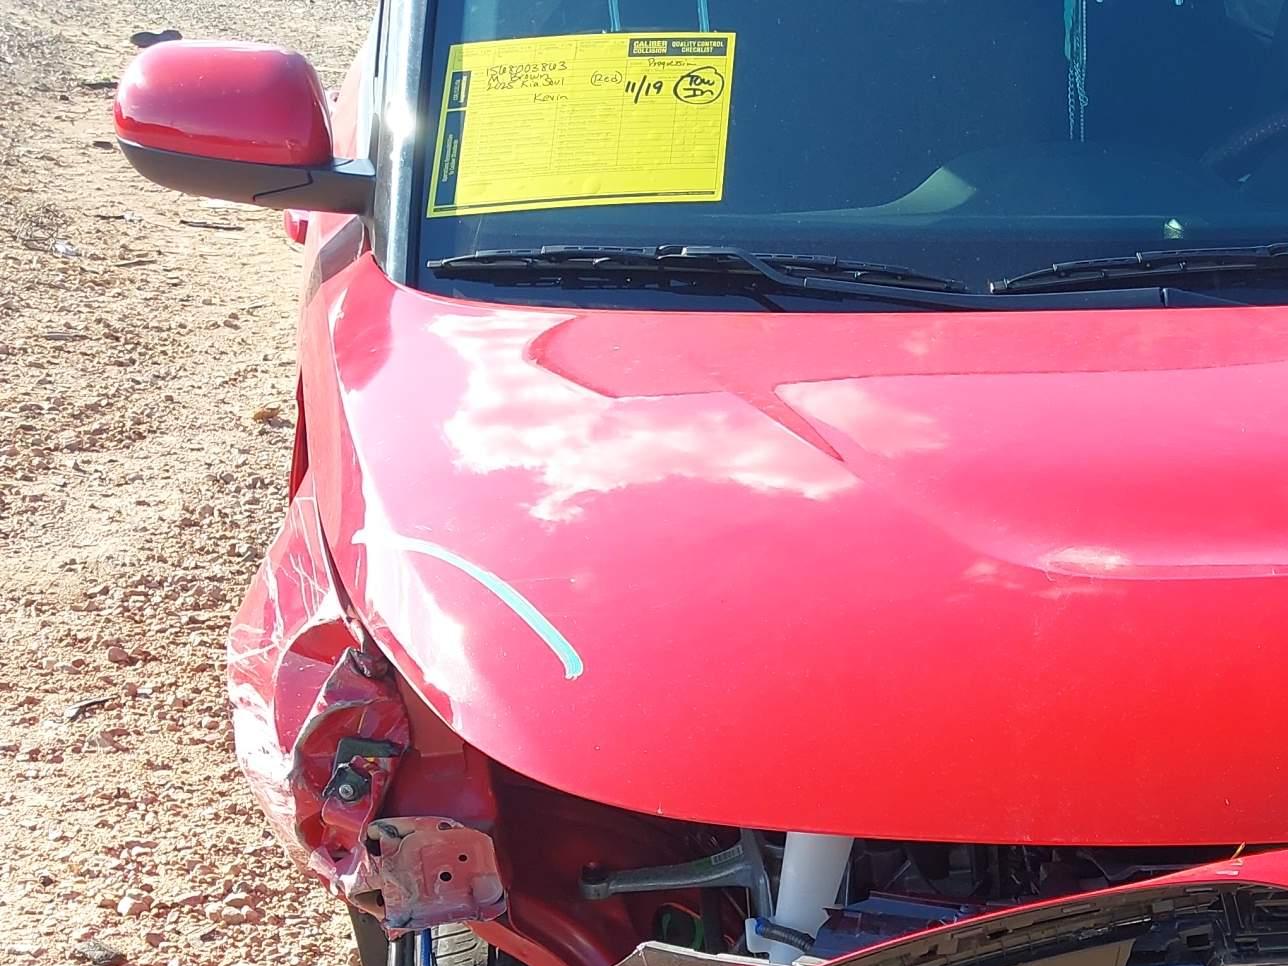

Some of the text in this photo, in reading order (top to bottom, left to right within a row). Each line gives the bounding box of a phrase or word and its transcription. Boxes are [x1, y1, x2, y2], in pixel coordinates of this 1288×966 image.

[634, 40, 667, 48] CALIBER
[688, 74, 715, 87] Tow
[625, 75, 663, 104] 11/19
